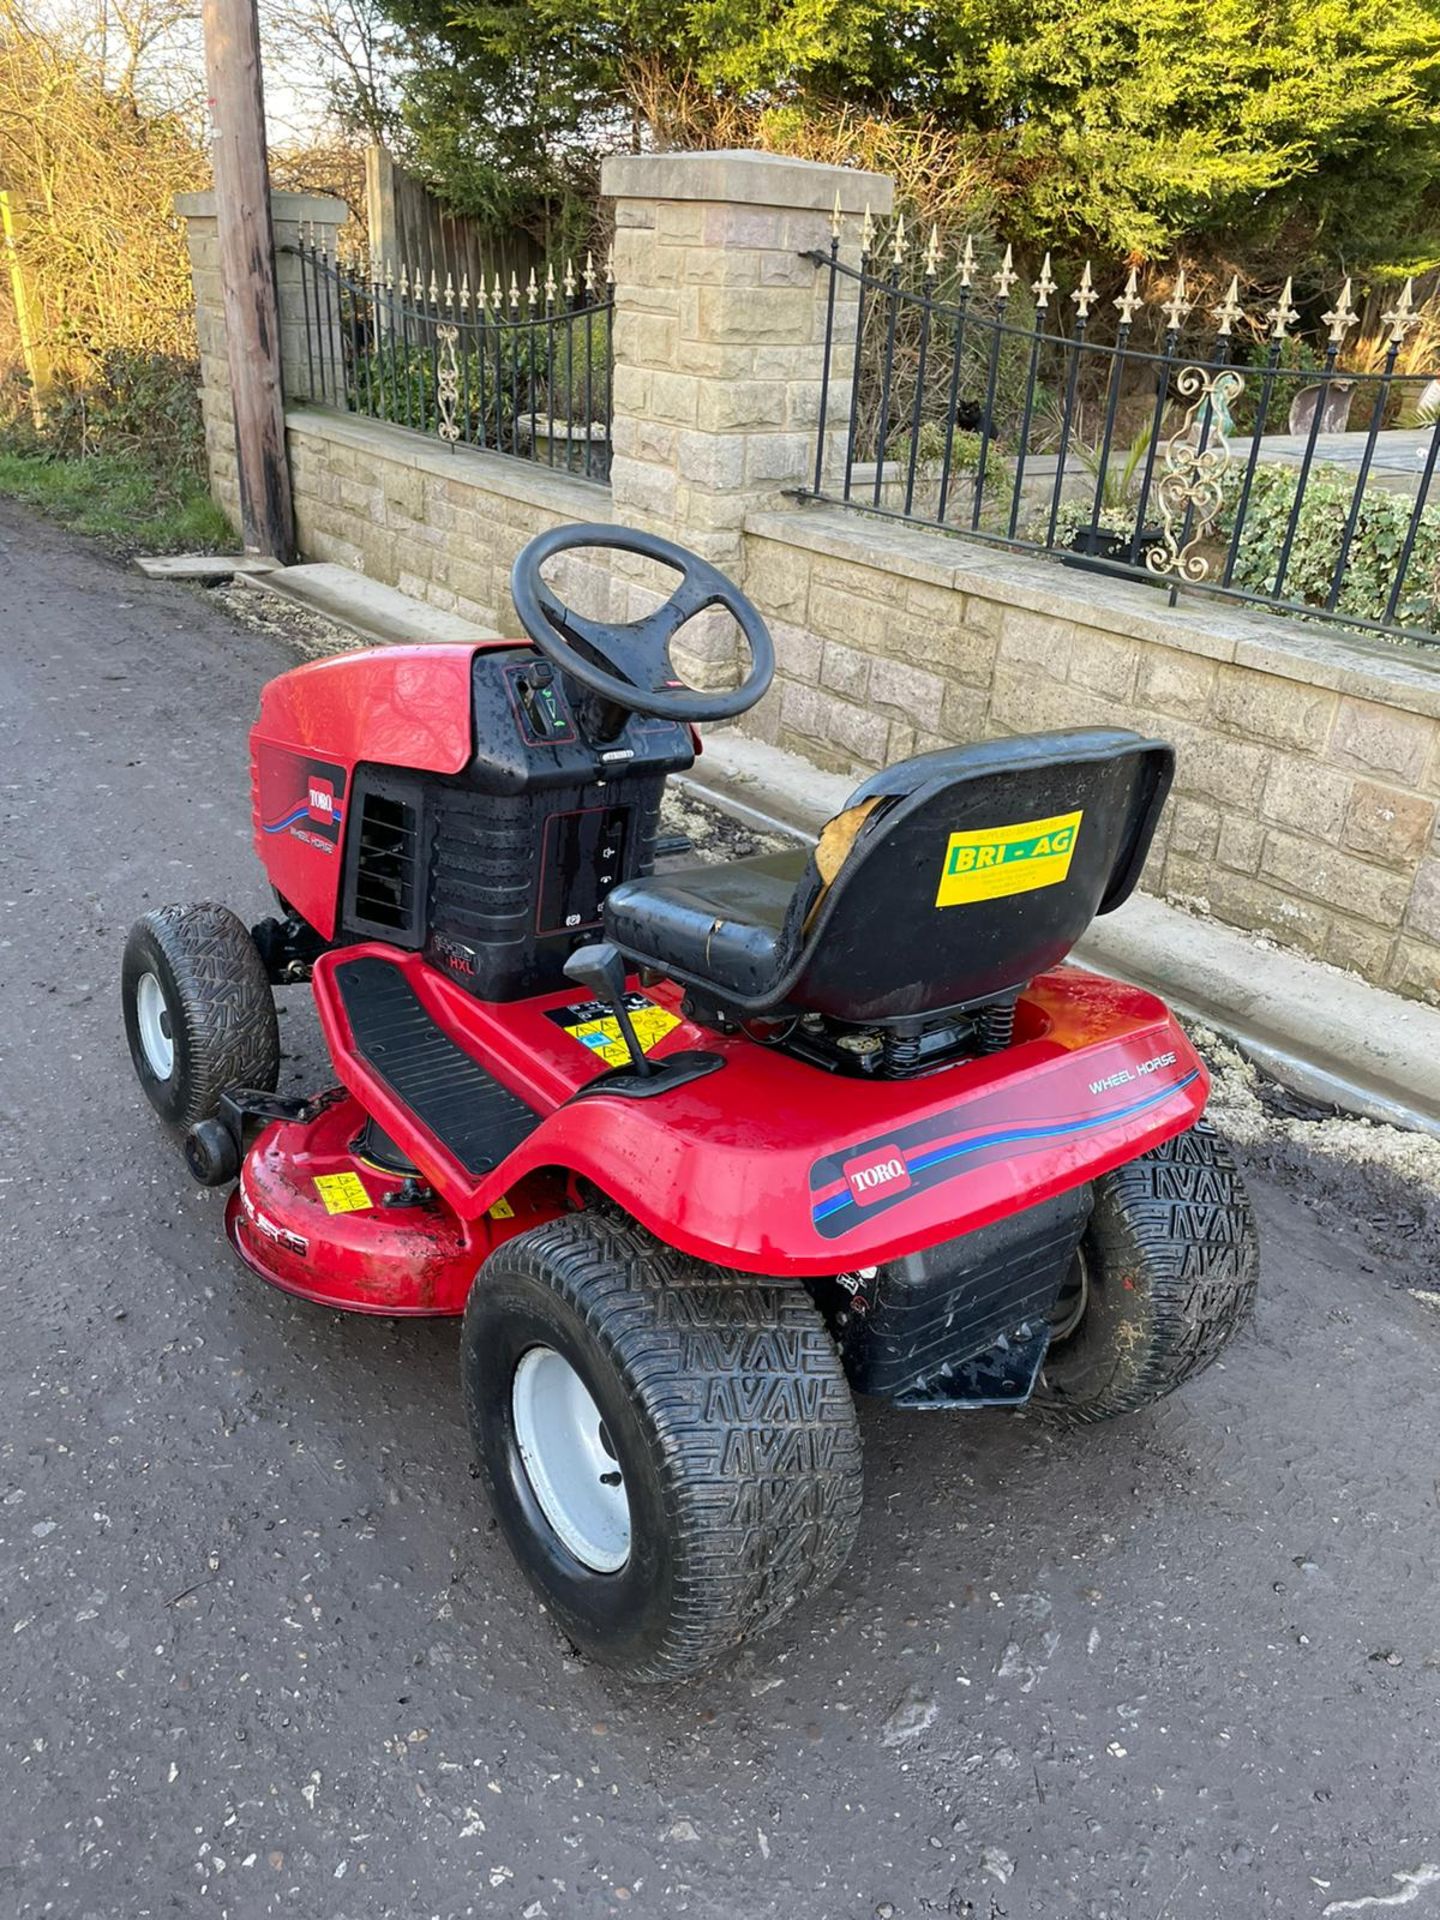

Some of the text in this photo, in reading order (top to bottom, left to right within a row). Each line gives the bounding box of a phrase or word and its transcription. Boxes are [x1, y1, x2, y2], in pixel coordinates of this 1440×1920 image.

[309, 789, 333, 812] TORO
[450, 955, 476, 977] HXL
[1089, 1051, 1177, 1095] WHEEL HORSE
[851, 1159, 905, 1192] TORO
